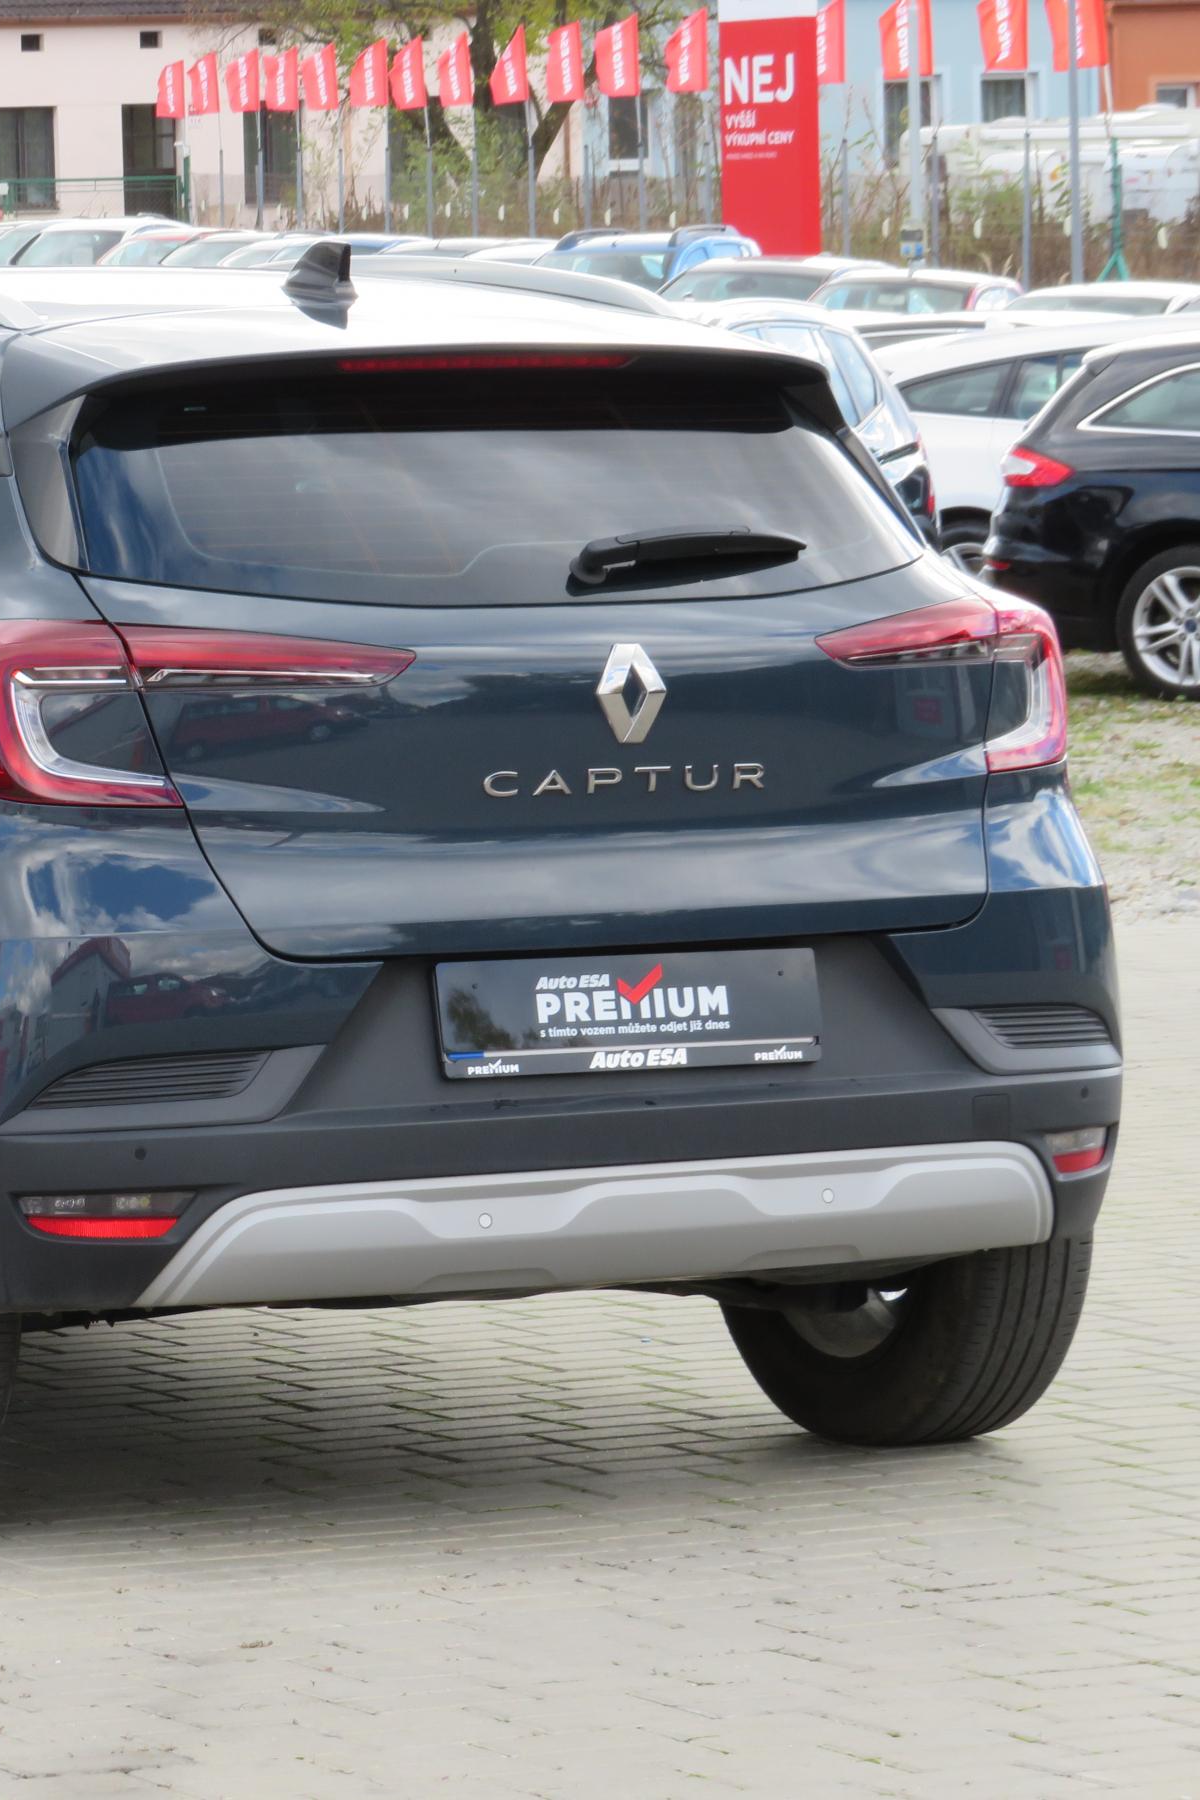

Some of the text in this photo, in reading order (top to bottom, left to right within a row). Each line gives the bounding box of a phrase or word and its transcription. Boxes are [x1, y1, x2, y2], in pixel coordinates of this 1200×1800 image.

[724, 52, 794, 105] NEJ
[767, 130, 795, 145] CENY
[483, 763, 765, 797] CAPTUR
[536, 973, 611, 990] Auto ESA
[536, 984, 730, 1024] PREMIUM
[539, 1019, 731, 1038] s tímto vozem můžete odjet již dnes
[589, 1047, 688, 1069] Auto ESA
[754, 1048, 803, 1061] PREMIUM
[467, 1062, 519, 1075] PREMIUM
